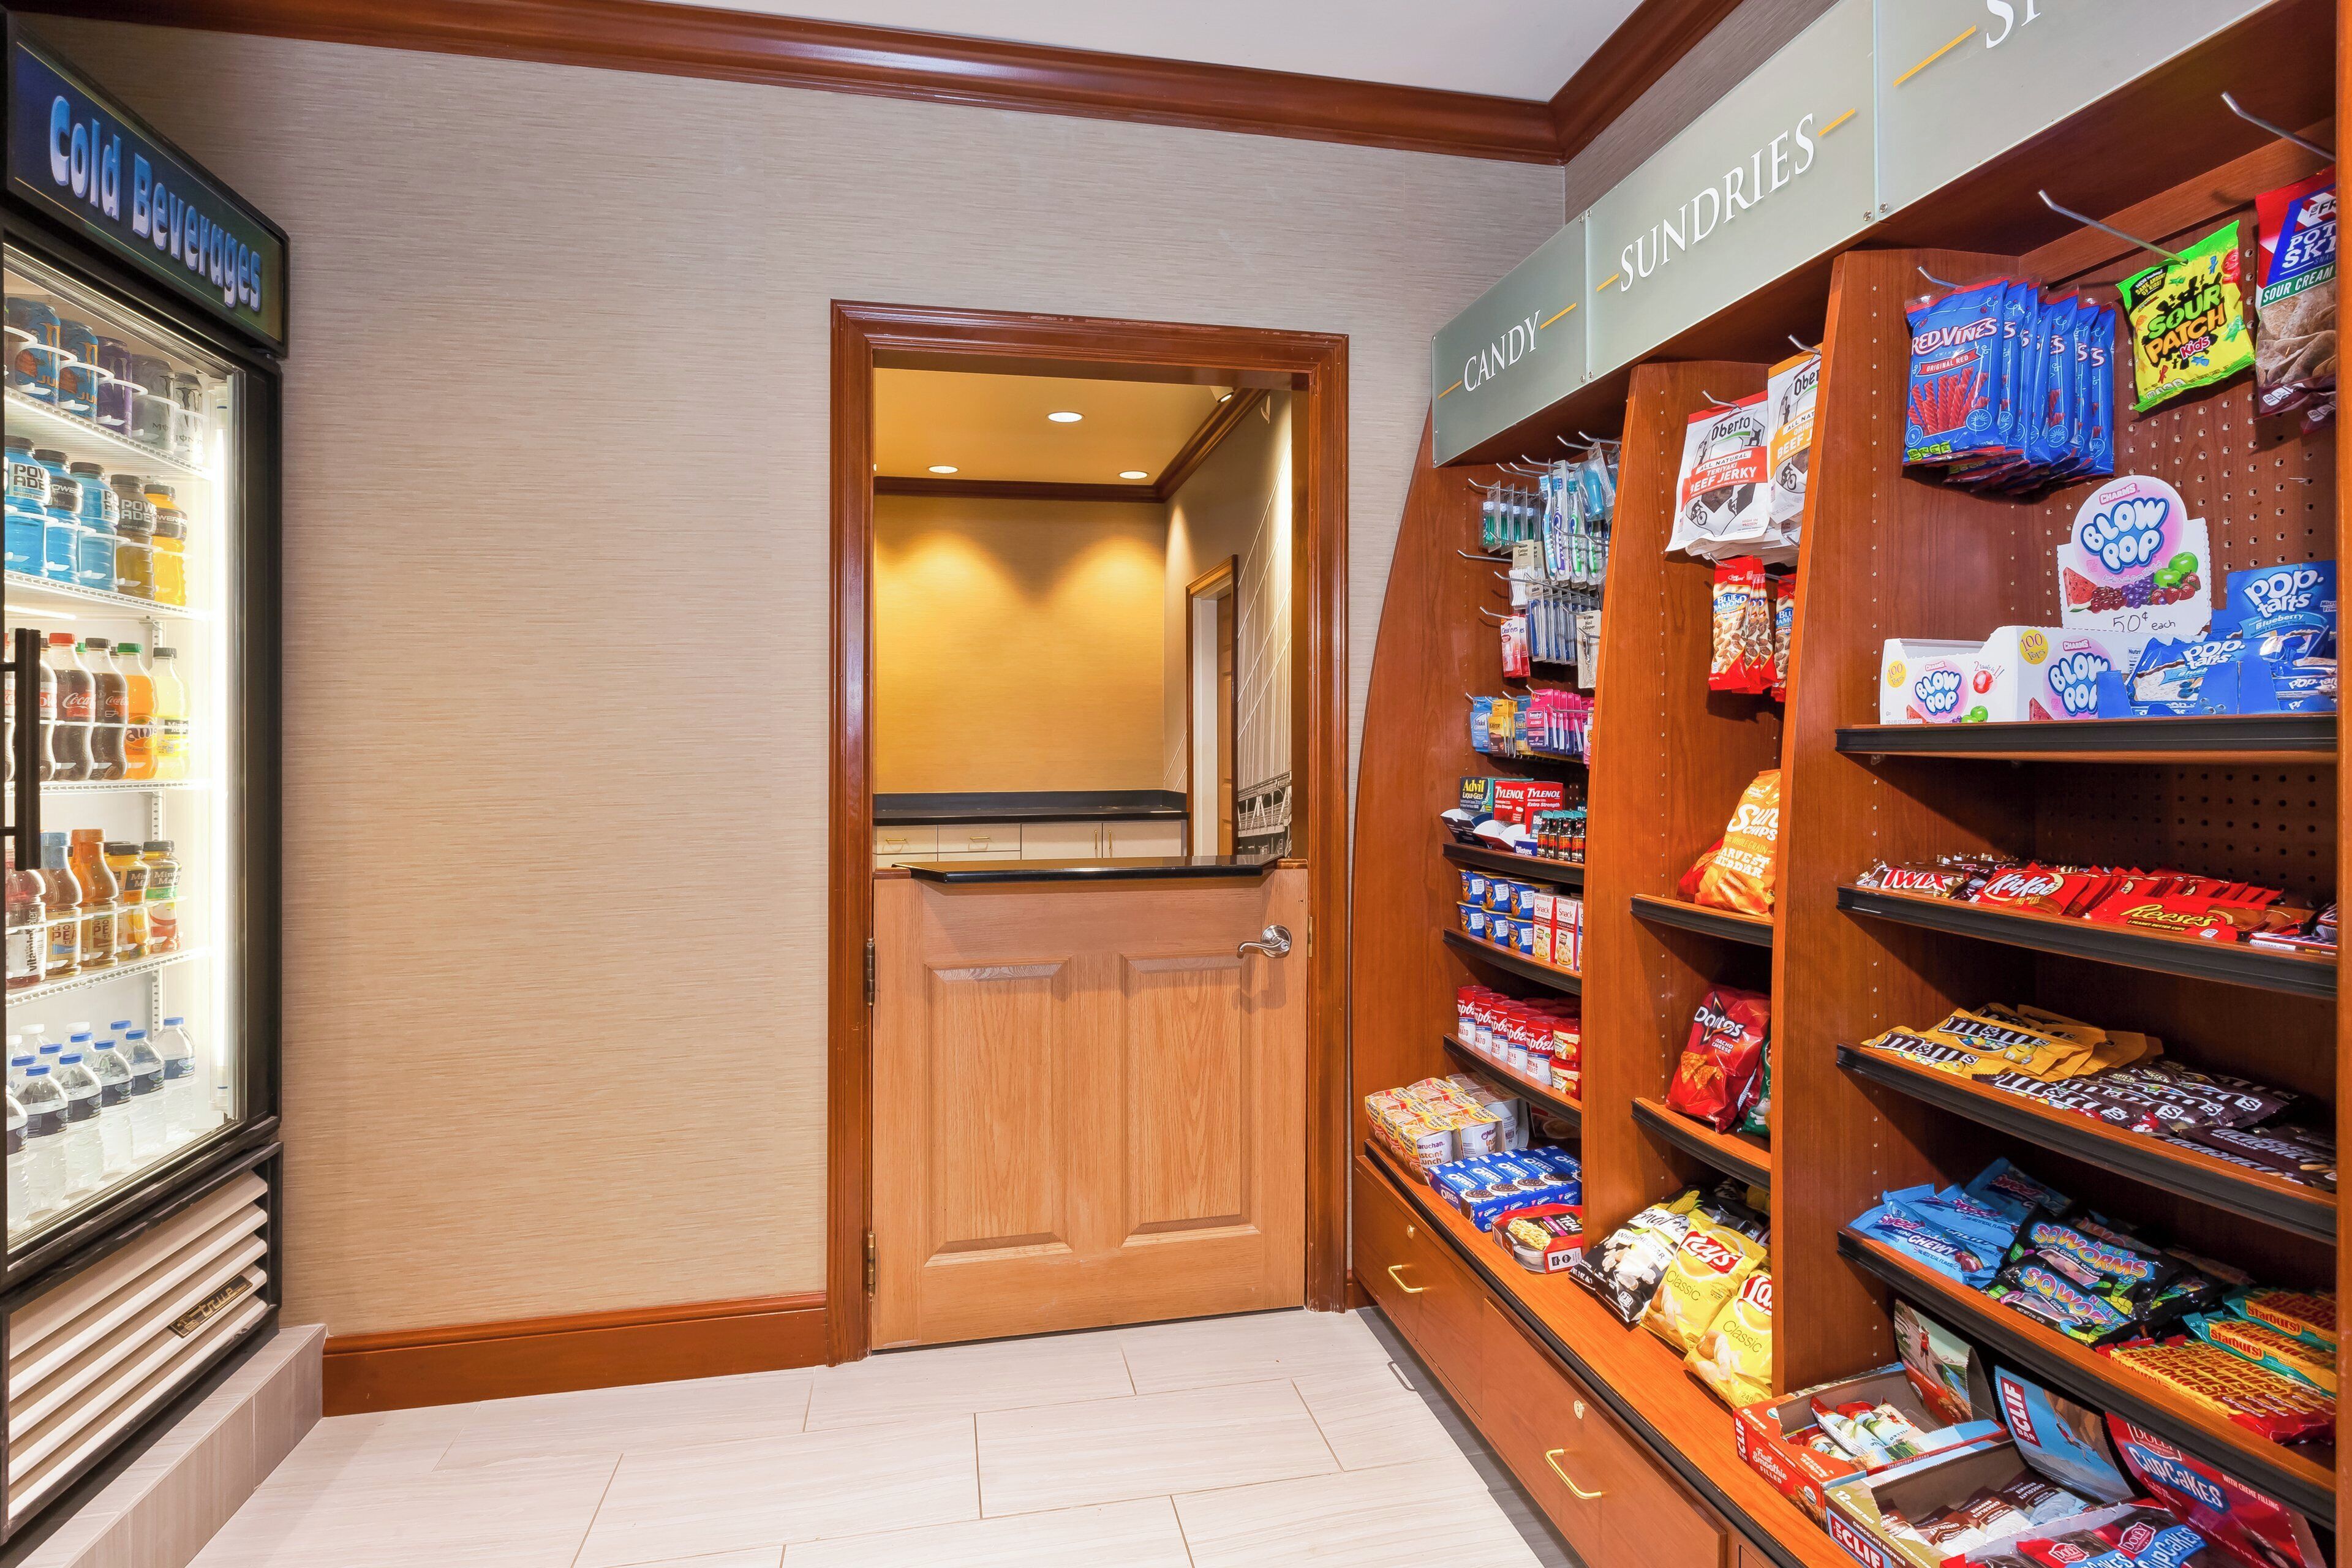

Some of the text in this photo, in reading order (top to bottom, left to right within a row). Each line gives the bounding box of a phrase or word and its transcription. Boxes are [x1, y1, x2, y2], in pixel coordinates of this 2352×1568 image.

[50, 96, 261, 312] Cold Beverages
[1621, 113, 1814, 292] SUNDRIES
[2135, 278, 2147, 288] NEW
[2135, 282, 2150, 295] SAME
[2149, 279, 2162, 290] KIDS!
[2263, 265, 2334, 303] SOUR CREAM
[2149, 284, 2221, 339] SOUR
[2146, 303, 2225, 364] PATCH
[1464, 310, 1540, 391] CANDY
[2180, 337, 2211, 360] Kids
[1926, 355, 1969, 372] ORIGINAL RED
[1711, 416, 1751, 441] Oberto
[1787, 421, 1799, 432] ALL
[1777, 434, 1804, 460] BEEF
[1700, 453, 1747, 472] ALL NATURAL
[1706, 462, 1738, 477] TERIYAKI
[1690, 476, 1715, 494] BEEF
[1717, 466, 1757, 483] JERKY
[2100, 484, 2136, 503] CHARMS
[2082, 500, 2166, 551] BLOW
[2103, 530, 2160, 570] POP
[1717, 594, 1737, 604] BLUE
[2257, 593, 2312, 618] tarts
[2113, 611, 2176, 632] 50¢ each
[2255, 613, 2304, 630] Blueberry
[2250, 628, 2266, 636] Naturally
[2021, 633, 2043, 652] 100
[2064, 639, 2089, 650] CHARMS
[2027, 649, 2046, 660] Pops
[1888, 663, 1903, 678] 100
[2050, 654, 2109, 692] BLOW
[1915, 671, 1961, 700] BLOW
[1925, 691, 1958, 714] POP
[1463, 778, 1485, 793] Advil
[1494, 786, 1525, 800] TYLENOL
[1527, 788, 1561, 799] TYLENOL
[1727, 804, 1779, 832] Sun
[1742, 825, 1778, 842] CHIPS
[1515, 845, 1532, 855] Blistex
[1732, 836, 1768, 854] WHOLE GRAIN
[1881, 867, 1954, 892] TWIX
[1536, 903, 1550, 913] Snack
[1558, 908, 1573, 919] Snack
[2120, 904, 2220, 927] Reese's
[2132, 919, 2151, 928] PEANUT
[1694, 1006, 1744, 1037] Doritos
[1711, 1042, 1732, 1054] CHEESE
[1715, 1038, 1734, 1050] NACHO
[1496, 1162, 1527, 1178] OREO
[1523, 1157, 1553, 1172] OREO
[1446, 1173, 1476, 1189] OREO
[1471, 1167, 1501, 1183] OREO
[1441, 1189, 1458, 1205] OREO
[1537, 1196, 1550, 1206] OREO
[1564, 1191, 1577, 1200] OREO
[1483, 1207, 1497, 1217] OREO
[1510, 1201, 1523, 1210] OREO
[1559, 1215, 1583, 1232] THAI
[1893, 1228, 1913, 1238] MINI
[1907, 1235, 1959, 1256] CHEWY
[2033, 1224, 2148, 1279] SQWORMS
[2094, 1241, 2135, 1259] NUCLEAR
[2060, 1250, 2104, 1276] GUMMI WORMS
[1666, 1270, 1701, 1302] Classic
[2247, 1305, 2301, 1333] Starburst
[1723, 1320, 1762, 1354] Classic
[2211, 1329, 2263, 1357] Starburst
[1741, 1392, 1754, 1403] 240
[2222, 1396, 2266, 1417] Original
[2003, 1382, 2031, 1432] CLIF
[1735, 1418, 1746, 1453] CLIF
[2016, 1427, 2036, 1442] BAR
[1756, 1447, 1773, 1464] Fruit
[1887, 1453, 1929, 1470] STRAWBERRY BANANA
[1752, 1450, 1788, 1481] Smoothie
[1760, 1466, 1782, 1484] FILLED
[2015, 1482, 2037, 1495] BROWNIE
[2018, 1483, 2045, 1500] CHOCOLATE
[2222, 1474, 2280, 1512] WITH FILLING
[1836, 1490, 1875, 1525] 12 ENERGY BARS
[1970, 1499, 1992, 1514] BROWNIE
[1974, 1500, 2001, 1518] CHOCOLATE
[1852, 1521, 1906, 1566] CHOCOLATE BROWNIE
[2123, 1524, 2149, 1551] DOLLY
[1842, 1529, 1880, 1568] CLIF
[2054, 1544, 2082, 1561] DOLLY
